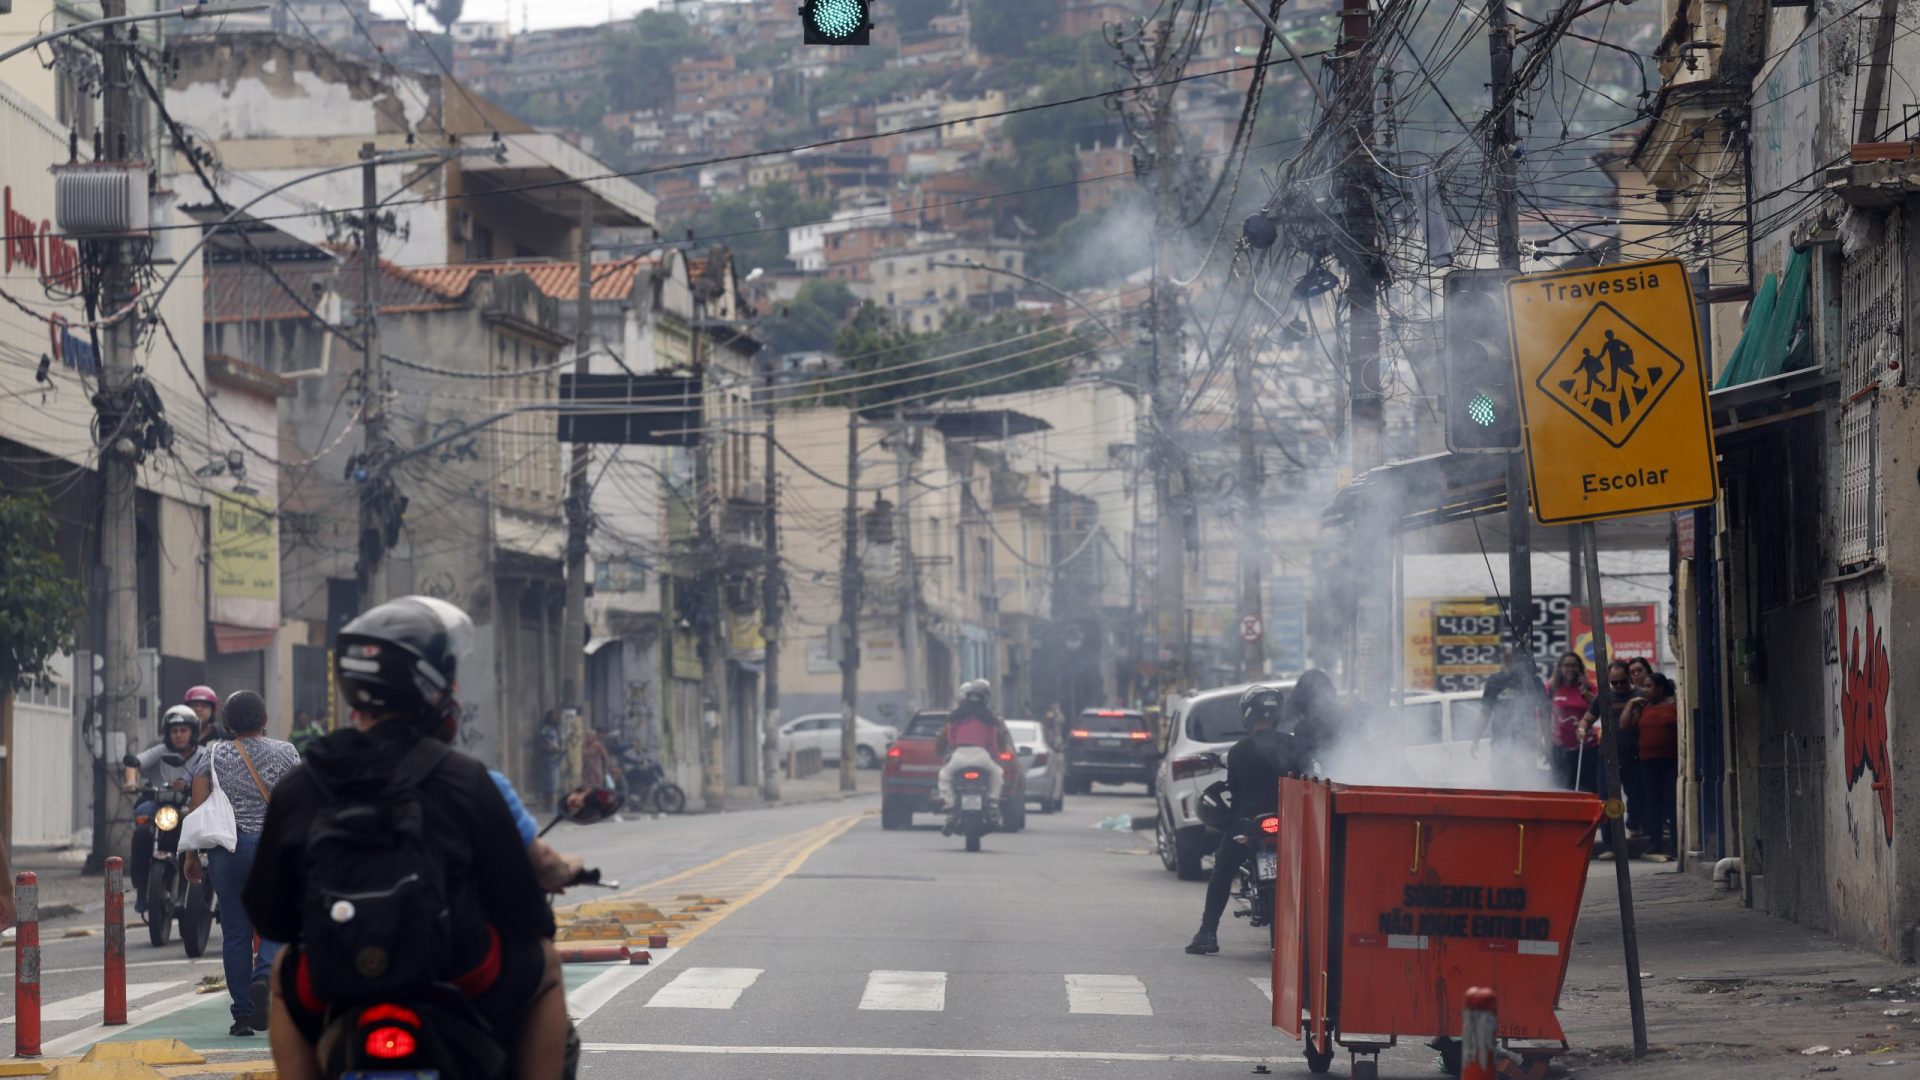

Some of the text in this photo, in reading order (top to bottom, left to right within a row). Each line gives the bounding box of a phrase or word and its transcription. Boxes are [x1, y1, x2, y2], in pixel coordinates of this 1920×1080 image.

[1541, 271, 1659, 302] Travessia
[1582, 467, 1669, 493] Escolar
[1439, 616, 1495, 635] 4.09
[1440, 646, 1495, 664] 5.82
[1403, 885, 1527, 911] SOMENTE LIXO
[1378, 908, 1414, 934] NÃO
[1471, 916, 1551, 939] ENTULHO
